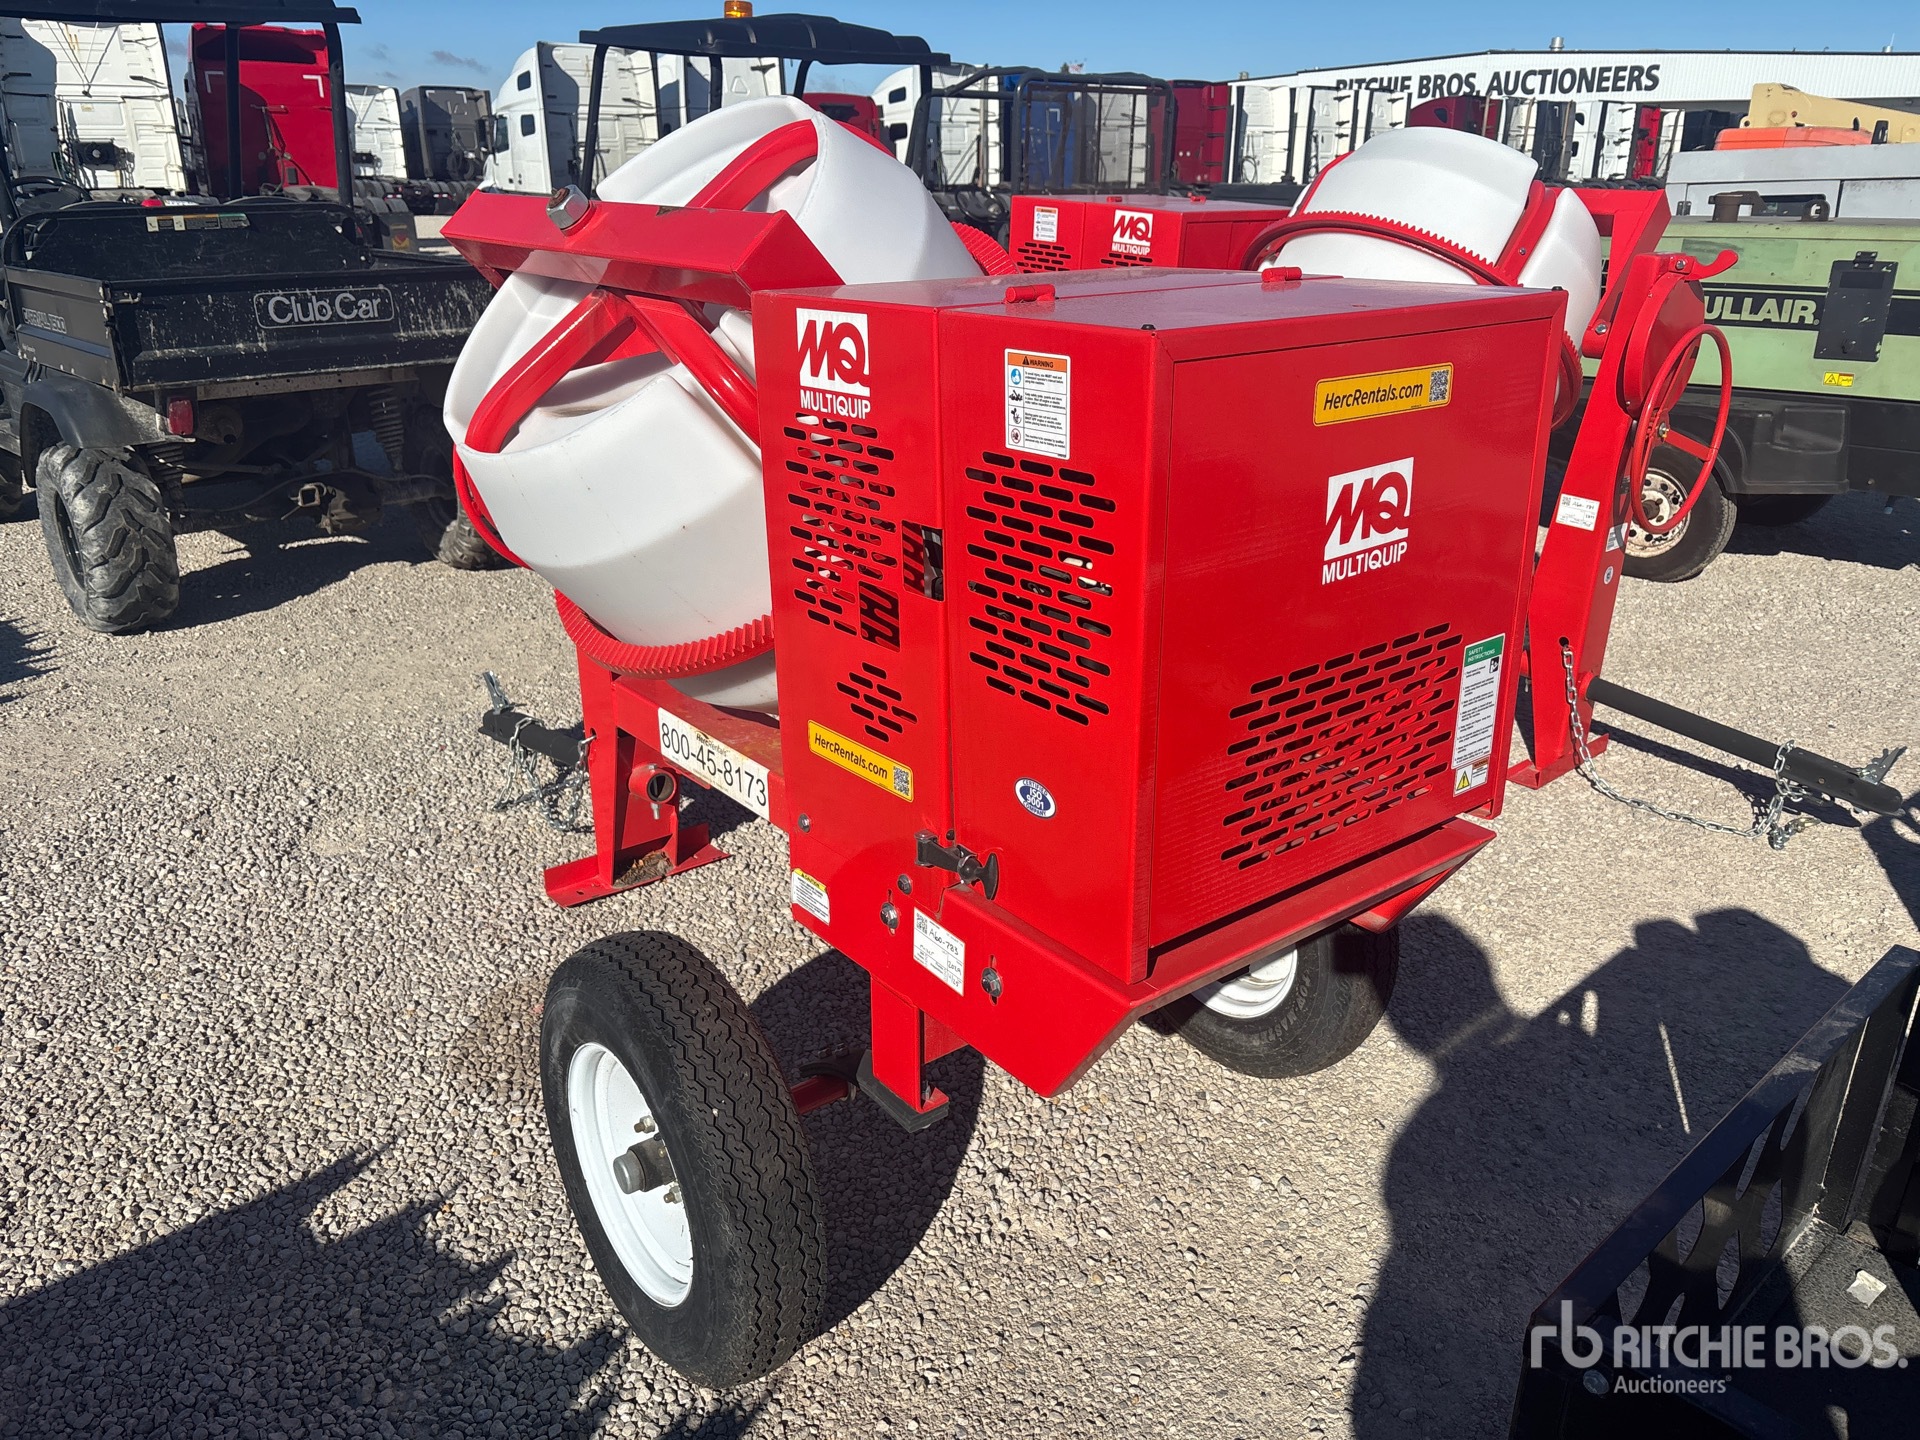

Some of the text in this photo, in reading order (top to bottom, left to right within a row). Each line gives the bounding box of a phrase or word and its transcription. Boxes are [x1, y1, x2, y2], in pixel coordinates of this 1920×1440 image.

[1486, 64, 1660, 96] AUCTIONEERS
[1111, 242, 1151, 256] MULTIQUIP
[267, 292, 382, 324] Club Car
[1704, 295, 1815, 325] ULLAIR
[797, 318, 870, 388] MQ
[1029, 359, 1054, 369] WARNING
[800, 388, 871, 420] MULTIQUIP
[1323, 383, 1424, 411] HercRentals.com
[1325, 471, 1409, 546] MQ
[1321, 541, 1408, 585] MULTIQUIP
[1467, 649, 1496, 662] INSTRUCTIONS
[1468, 646, 1484, 656] SAFETY
[661, 722, 767, 807] 800-45-8173
[814, 732, 888, 780] HercRentals.com
[1026, 794, 1044, 810] 9001
[1029, 787, 1043, 801] ISO
